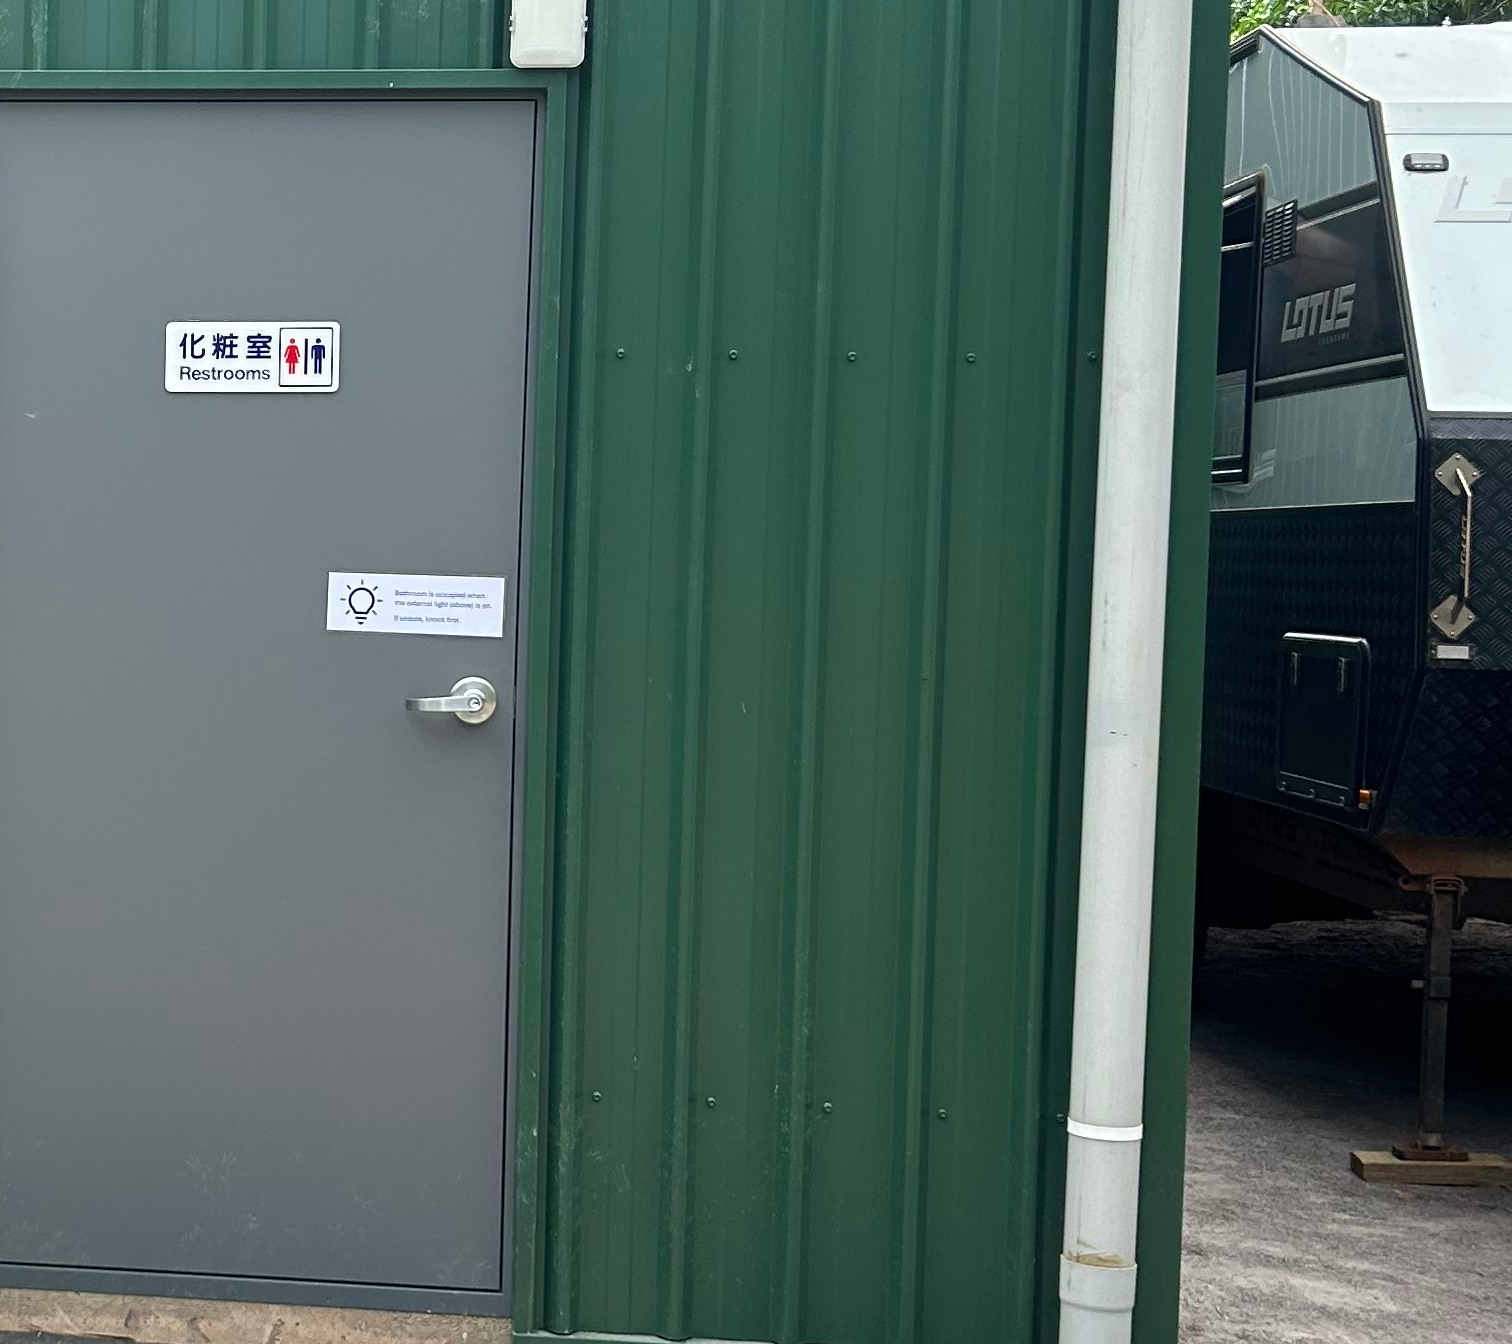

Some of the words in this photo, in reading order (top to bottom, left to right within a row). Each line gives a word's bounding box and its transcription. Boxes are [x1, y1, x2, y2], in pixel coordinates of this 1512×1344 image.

[1280, 282, 1357, 343] LOTUS
[179, 332, 273, 360] 化粧室
[179, 365, 271, 381] Restrooms
